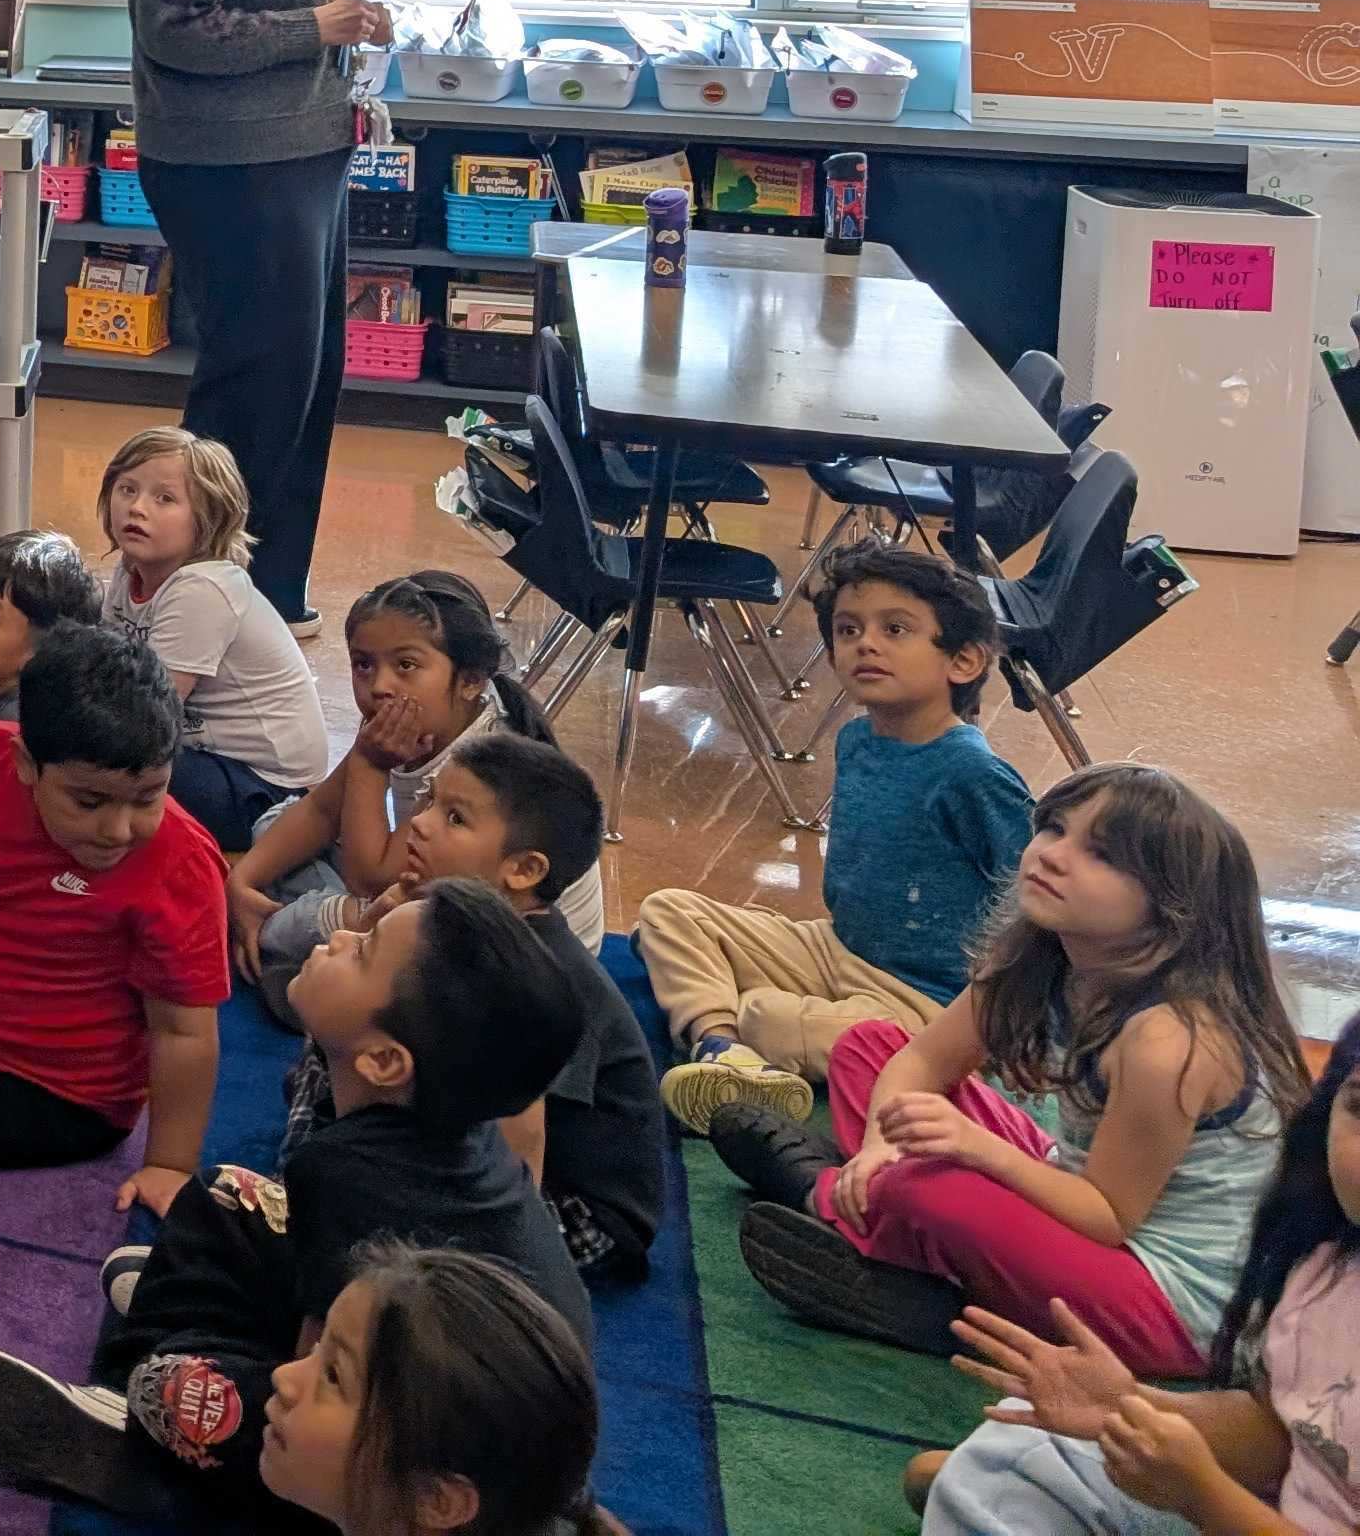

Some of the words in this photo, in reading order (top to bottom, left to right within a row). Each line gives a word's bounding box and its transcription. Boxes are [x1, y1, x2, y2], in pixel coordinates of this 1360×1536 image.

[378, 166, 408, 179] BACK
[470, 175, 518, 187] Caterpillar
[475, 185, 485, 194] to
[486, 184, 528, 197] Butterfly
[1172, 242, 1236, 267] Please
[1156, 269, 1185, 285] DO
[1211, 271, 1253, 287] NOT
[1159, 291, 1197, 310] Turn
[1214, 291, 1241, 311] off
[57, 871, 89, 892] NIKE
[178, 1378, 205, 1425] QUIT
[200, 1382, 226, 1434] NEVER
